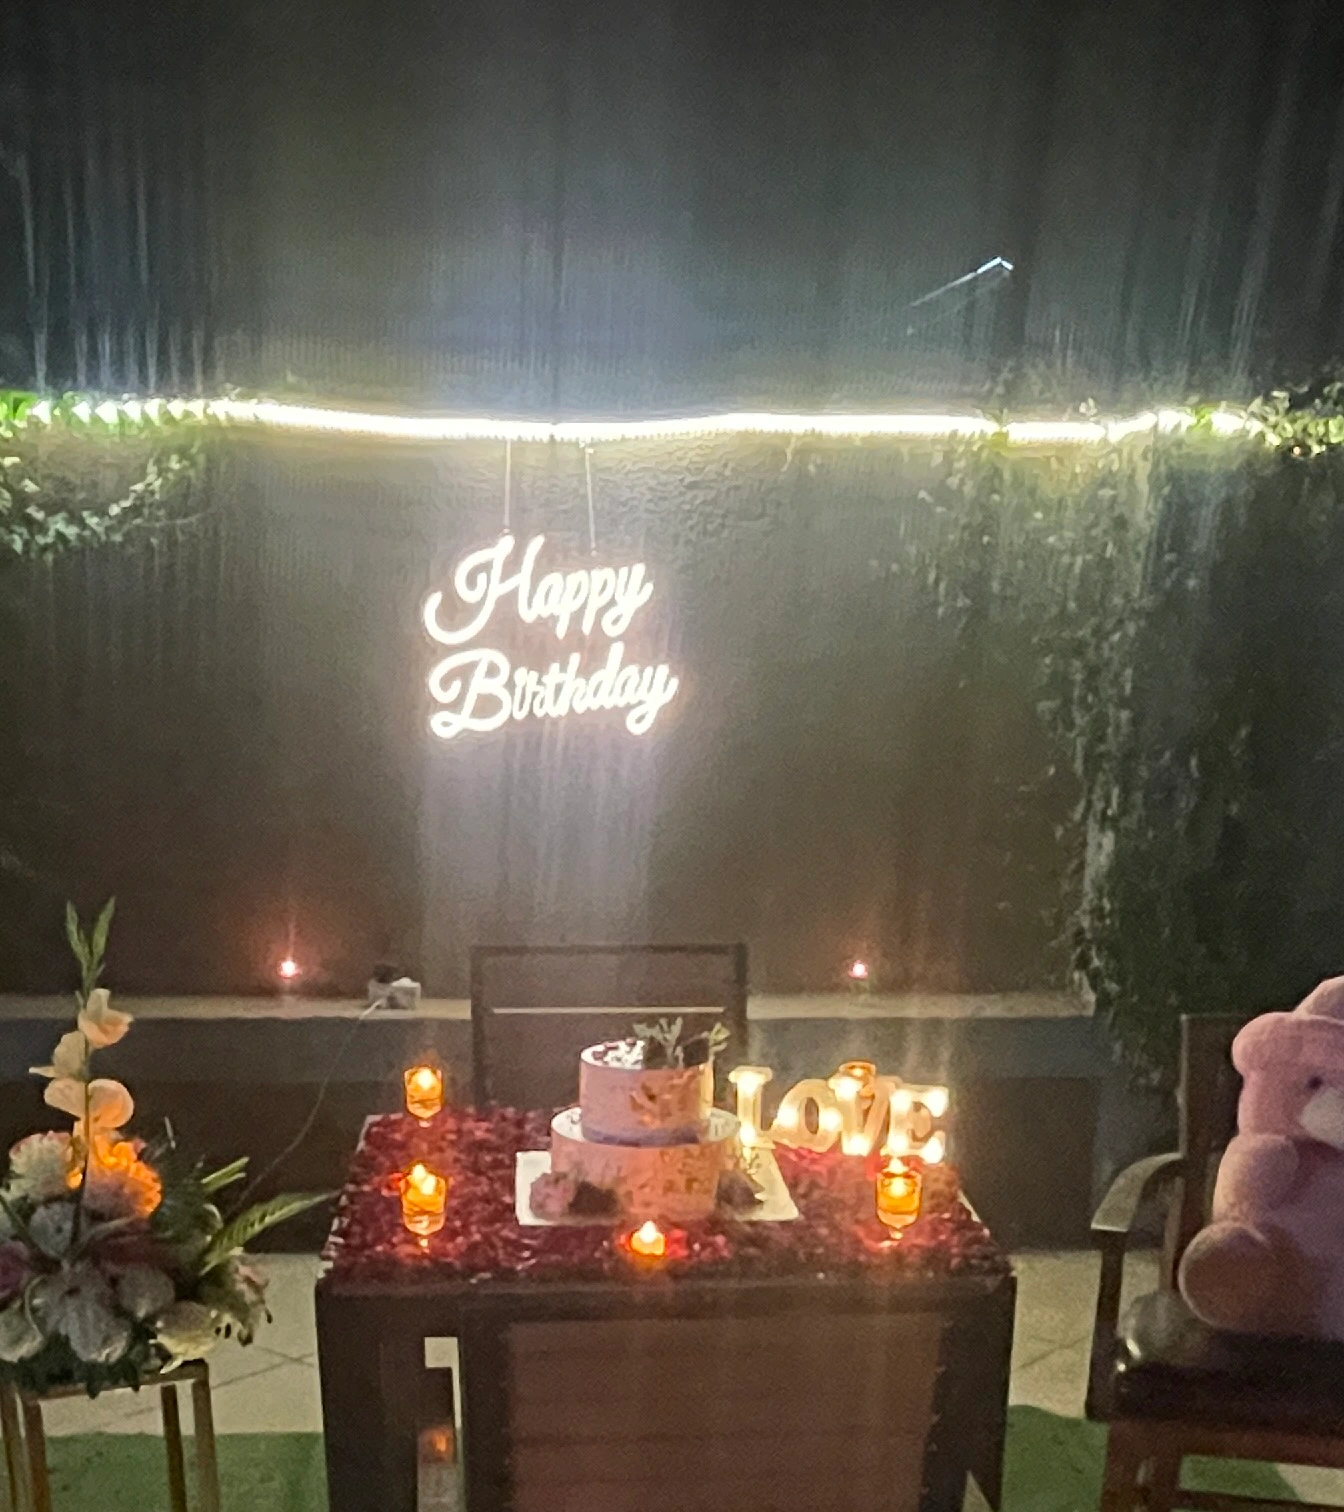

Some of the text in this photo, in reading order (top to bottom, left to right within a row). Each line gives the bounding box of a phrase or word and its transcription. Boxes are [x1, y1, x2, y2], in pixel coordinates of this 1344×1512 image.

[423, 533, 654, 645] Happy
[427, 641, 680, 739] Birthday
[727, 1065, 950, 1165] LOVE
